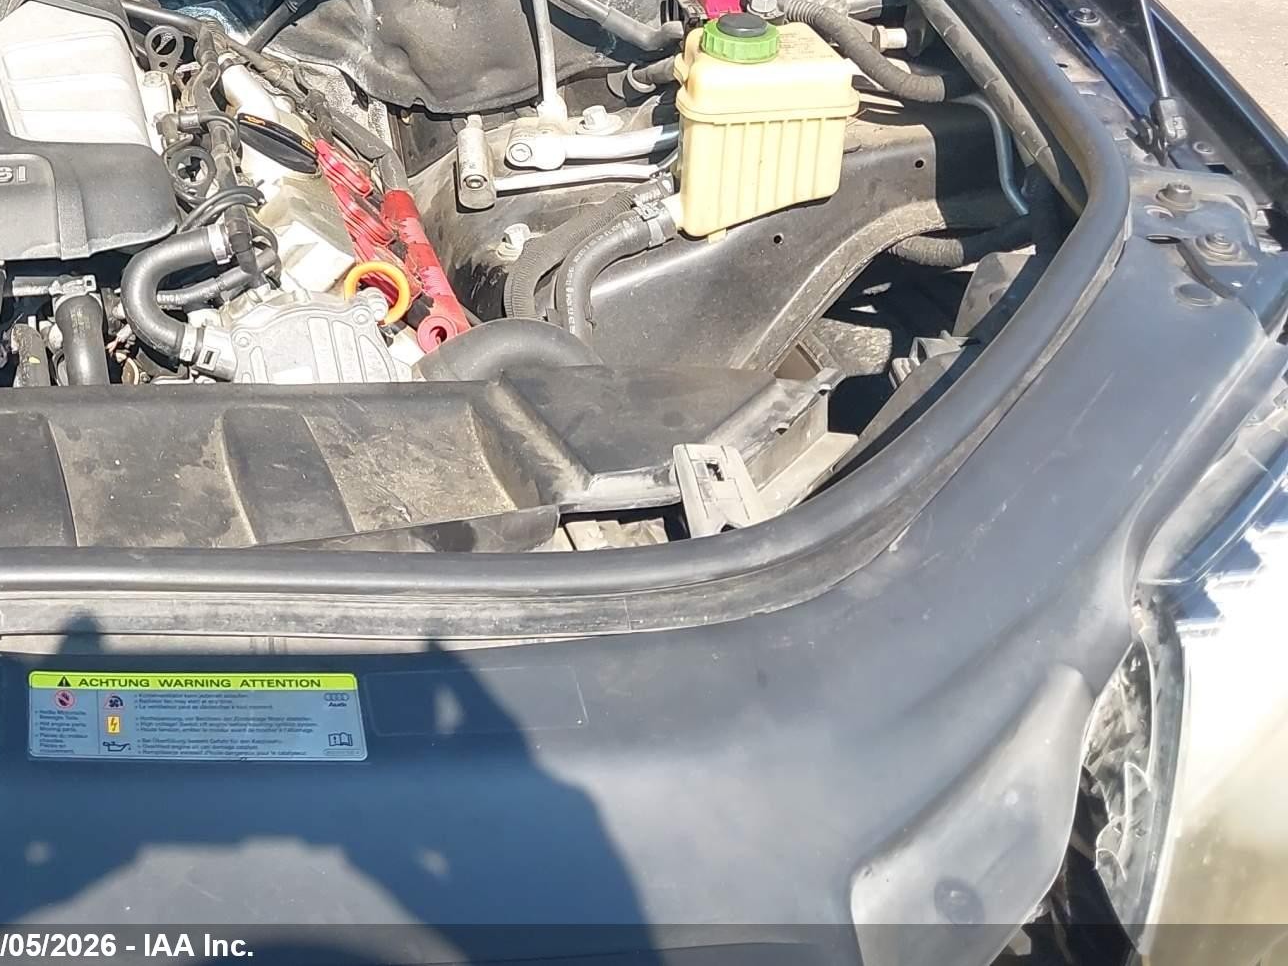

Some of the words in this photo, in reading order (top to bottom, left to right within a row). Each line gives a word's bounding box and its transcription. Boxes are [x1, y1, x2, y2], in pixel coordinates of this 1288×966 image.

[78, 678, 150, 688] ACHTUNG
[158, 678, 232, 688] WARNING
[239, 678, 321, 688] ATTENTION
